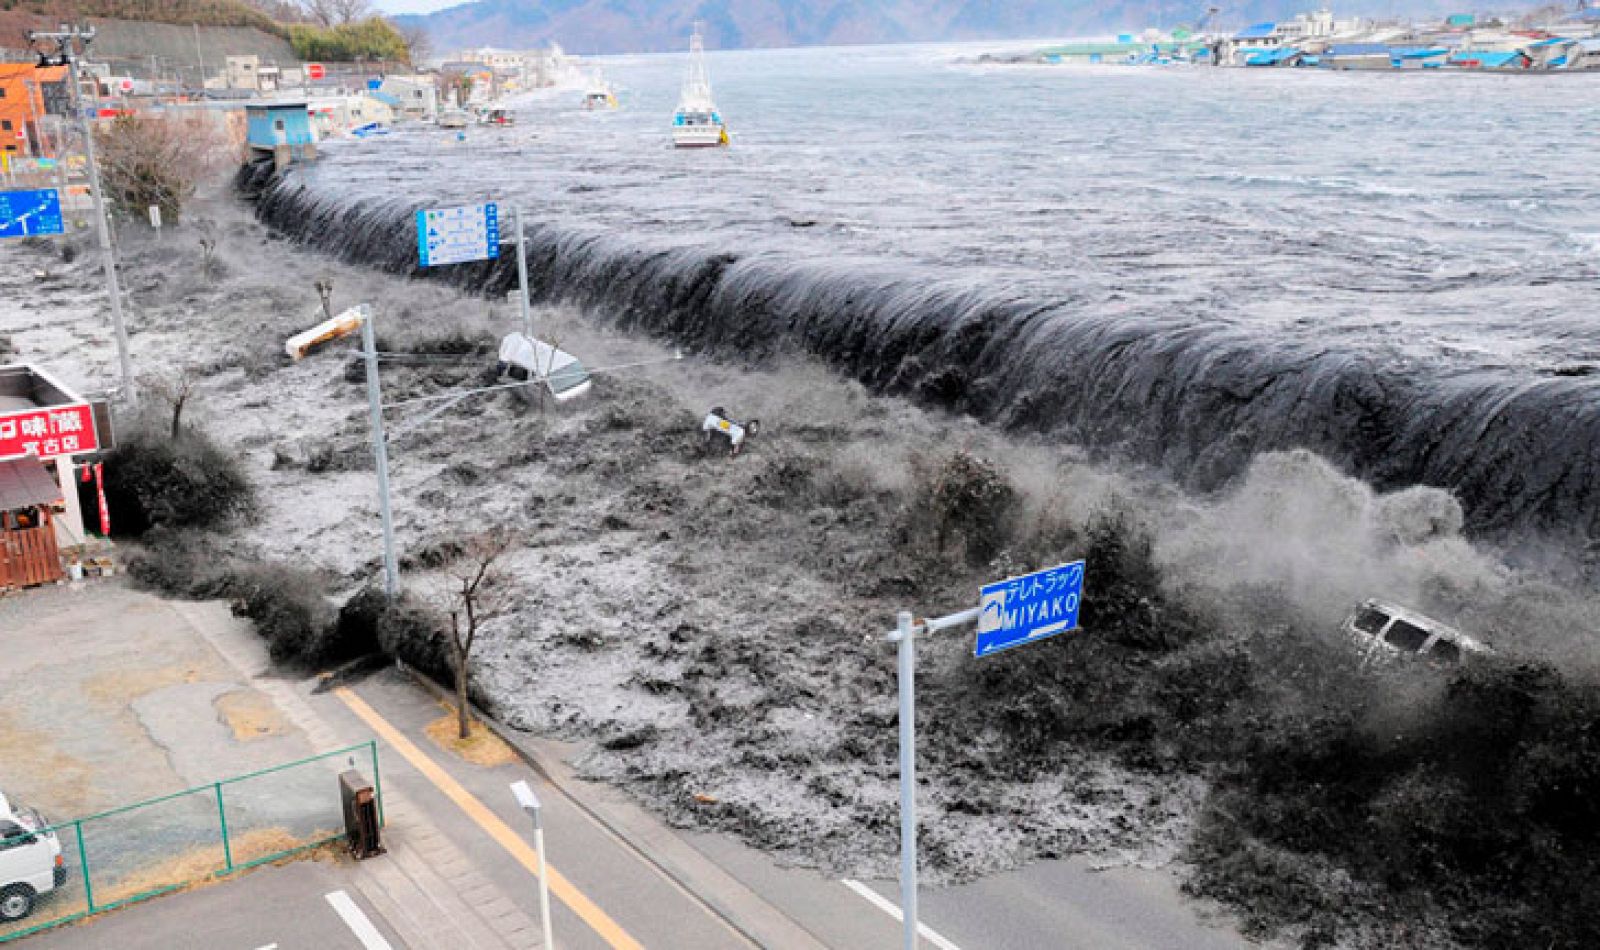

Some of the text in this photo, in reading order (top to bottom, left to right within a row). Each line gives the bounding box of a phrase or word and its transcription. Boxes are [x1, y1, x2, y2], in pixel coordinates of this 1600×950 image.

[1006, 564, 1081, 603] テレトラック
[1002, 592, 1078, 631] MIYAKO
